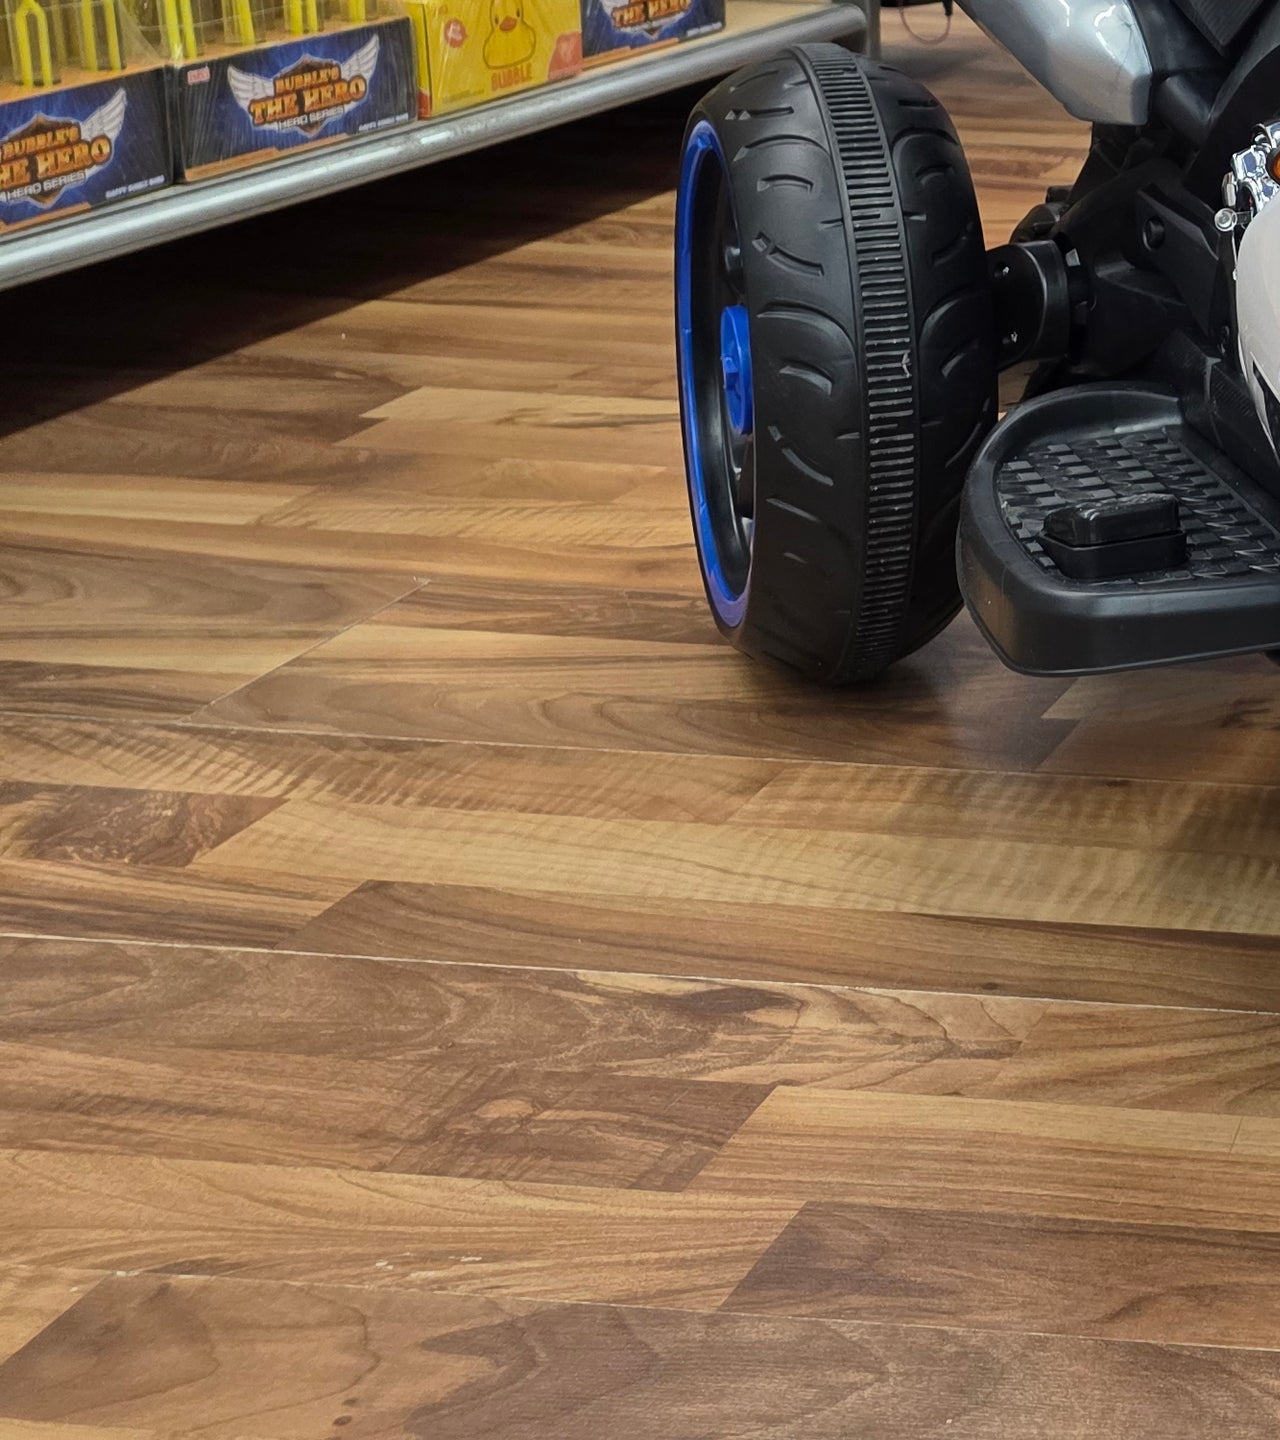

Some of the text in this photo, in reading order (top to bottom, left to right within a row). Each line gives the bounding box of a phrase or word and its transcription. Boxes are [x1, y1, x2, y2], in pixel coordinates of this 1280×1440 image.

[611, 3, 646, 28] THE
[491, 64, 532, 92] BUBBLE
[251, 77, 366, 124] THE HERO
[0, 136, 112, 187] HE HERO
